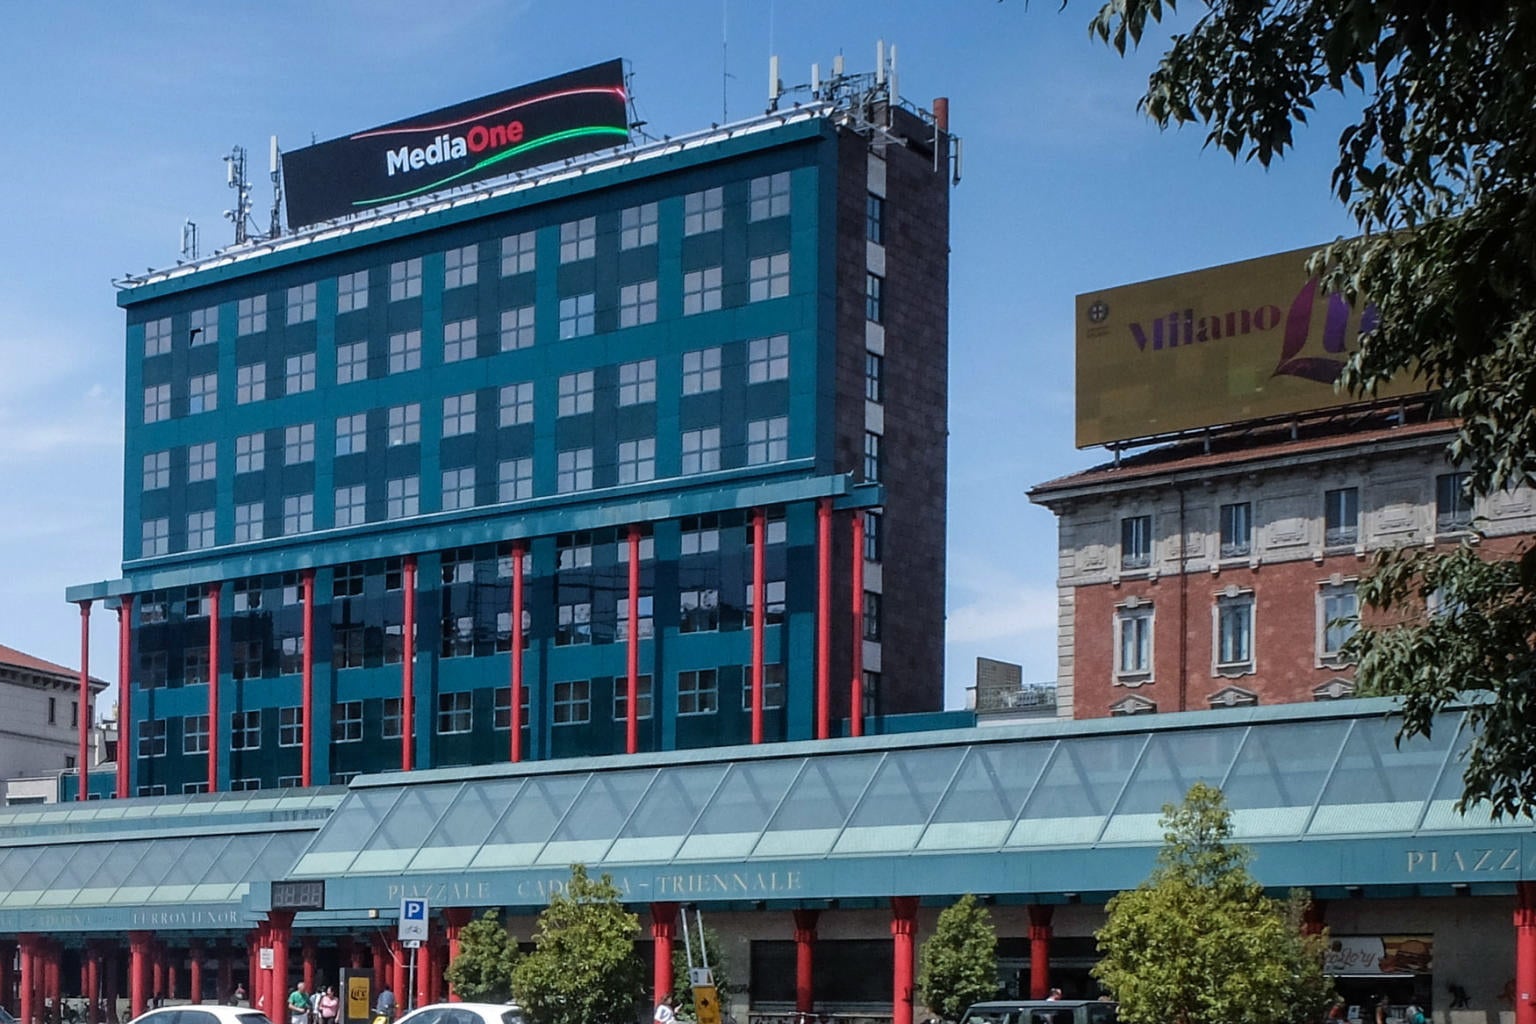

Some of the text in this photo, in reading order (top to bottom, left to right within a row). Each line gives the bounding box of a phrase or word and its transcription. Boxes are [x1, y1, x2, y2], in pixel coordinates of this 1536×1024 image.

[386, 120, 524, 177] MediaOne
[1128, 304, 1281, 353] Milano
[1405, 847, 1536, 874] PIAZZ
[388, 881, 490, 901] PIAZZALE
[655, 870, 802, 895] TRIENNALE
[407, 903, 421, 918] P
